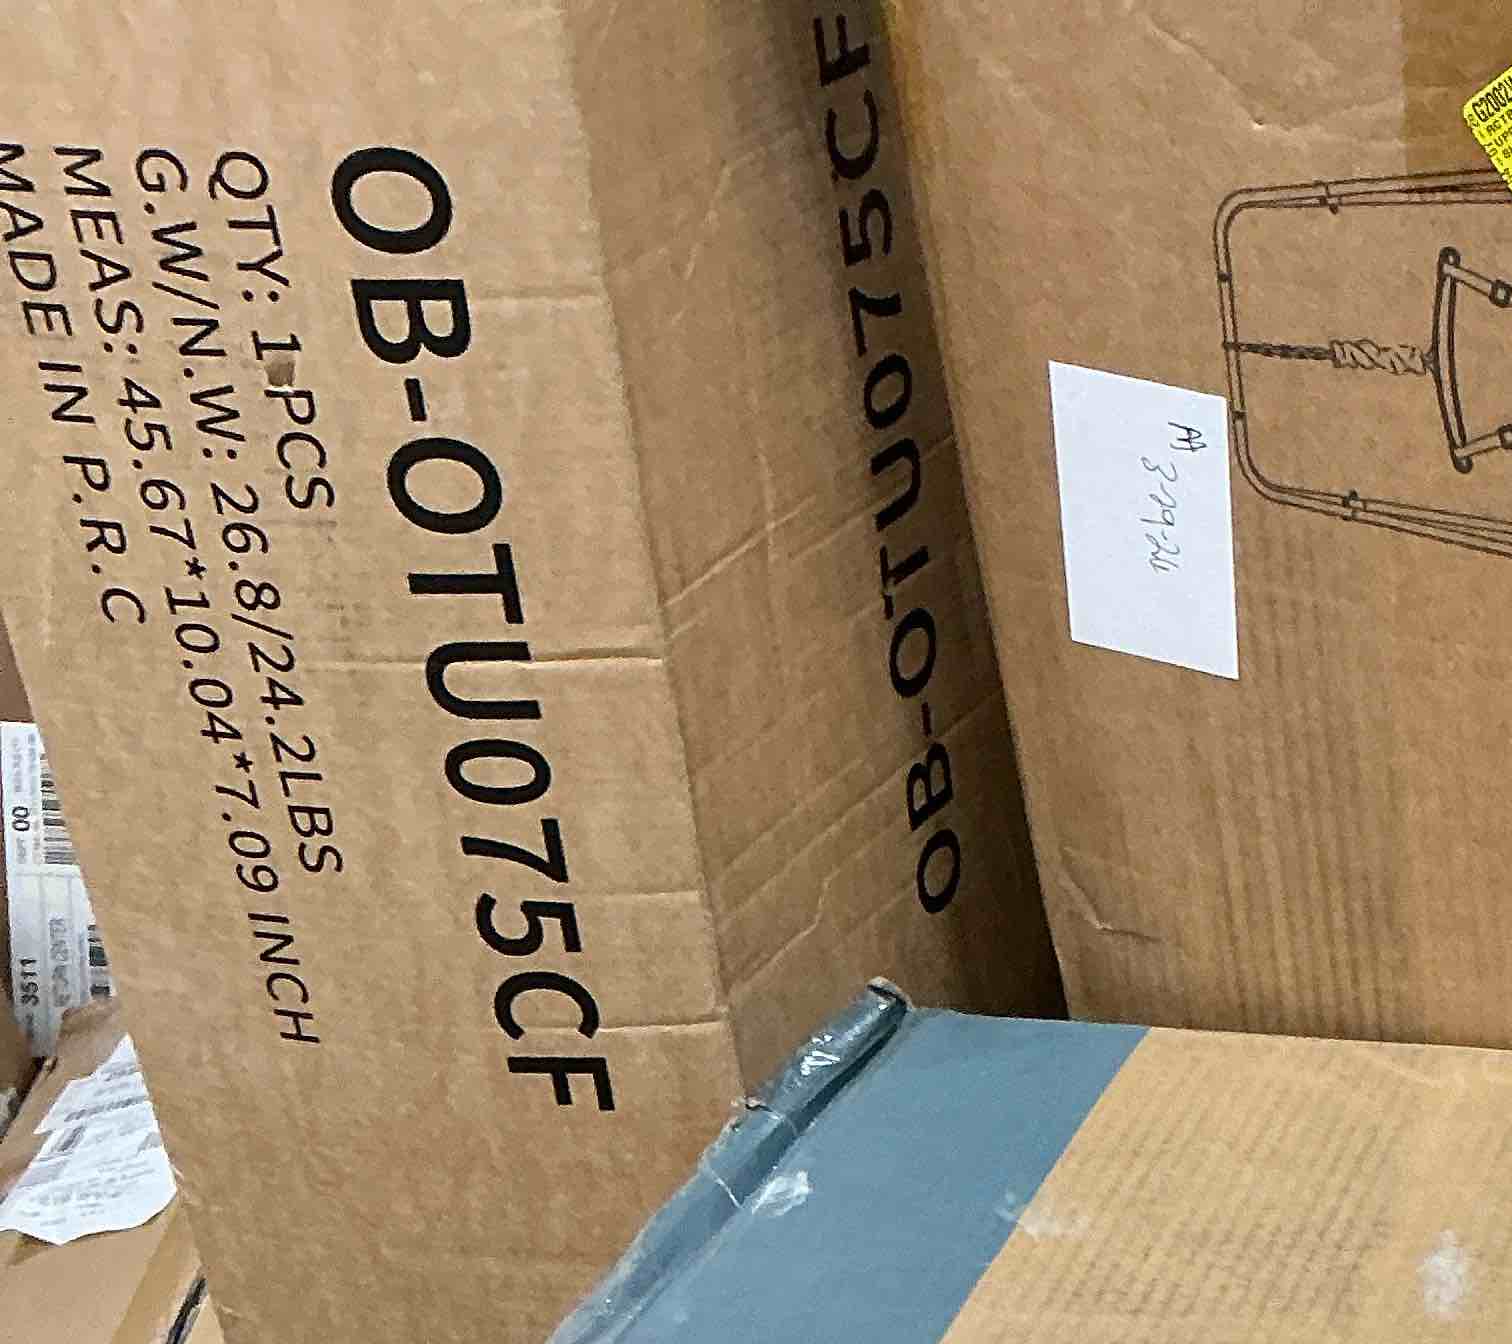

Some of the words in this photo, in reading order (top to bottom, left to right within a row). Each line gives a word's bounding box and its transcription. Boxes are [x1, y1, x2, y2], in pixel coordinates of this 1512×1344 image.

[0, 143, 74, 336] MADE
[38, 361, 97, 425] IN
[208, 150, 291, 303] QTY:
[251, 330, 303, 361] 1
[264, 388, 336, 509] PCS
[815, 12, 962, 916] OB-OTU075CF
[53, 146, 145, 356] MEAS:
[247, 912, 321, 1044] INCH
[135, 148, 247, 460] G.W/N.W:
[210, 483, 344, 874] 26.8/24.2LBS
[330, 146, 615, 1113] OB-OTU075CF
